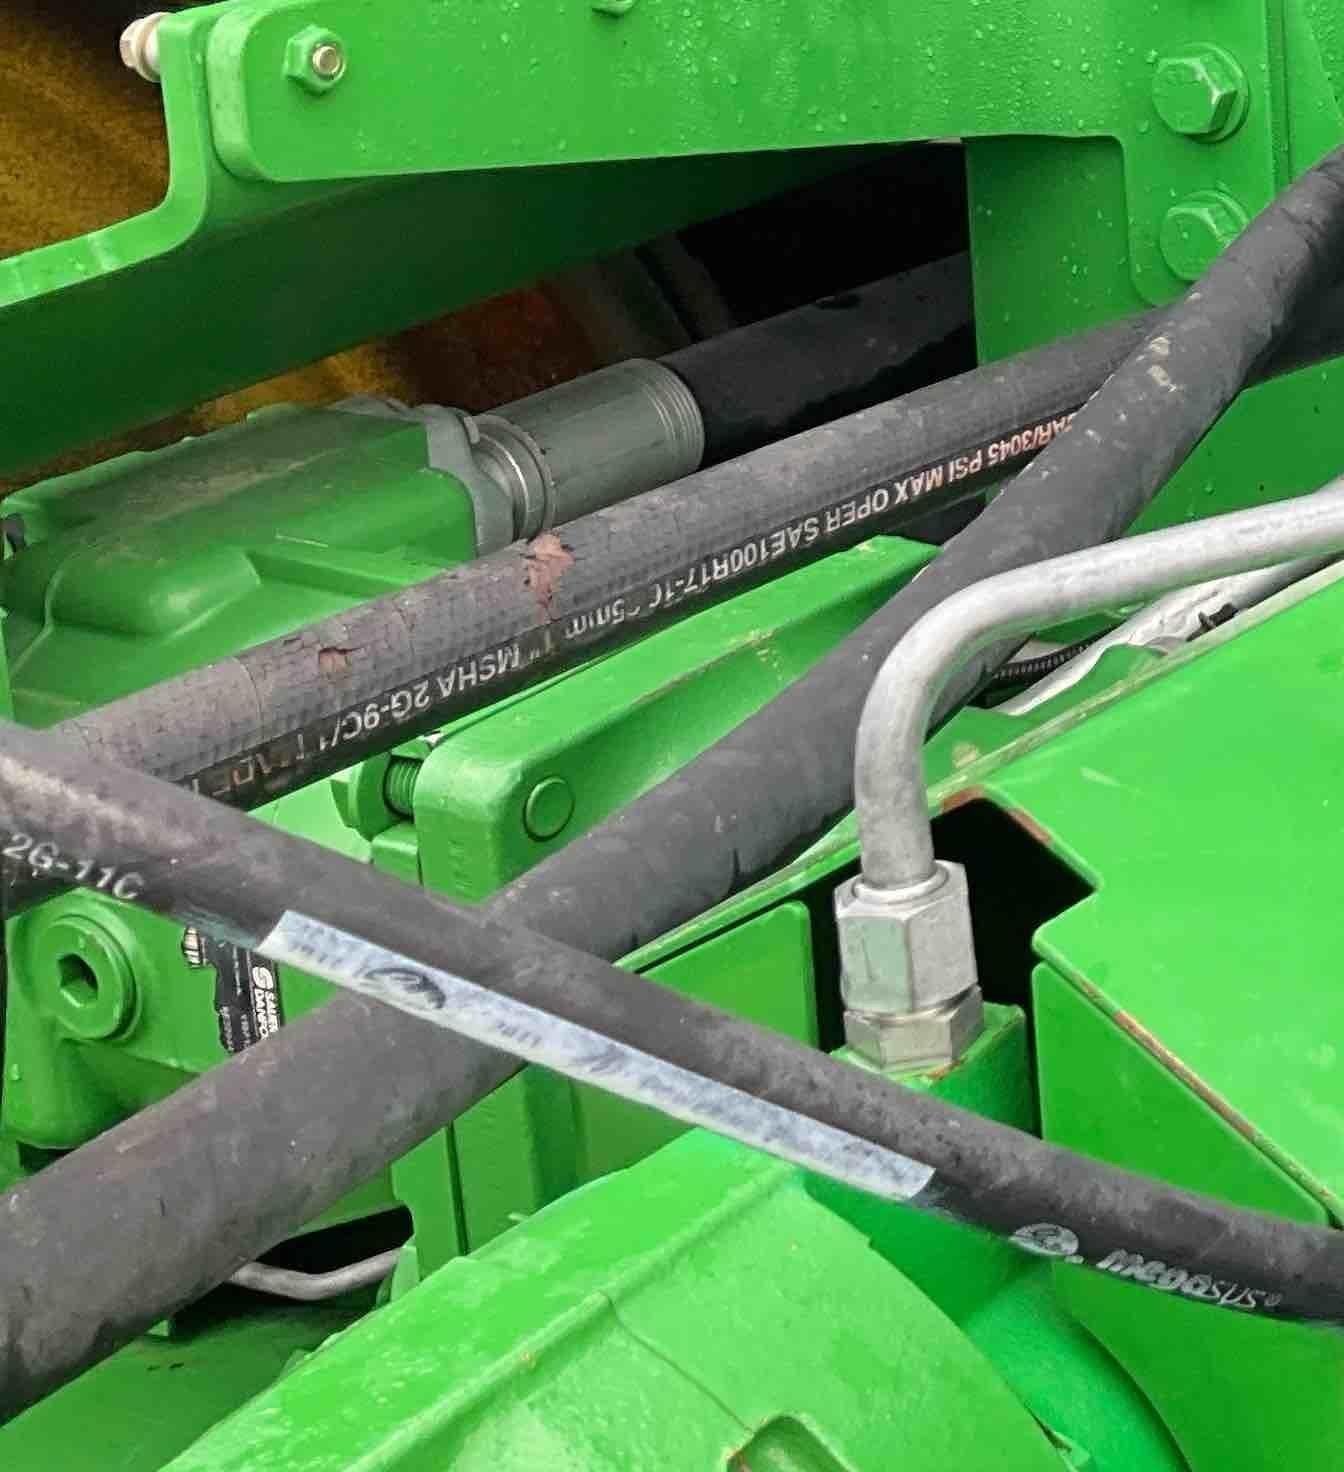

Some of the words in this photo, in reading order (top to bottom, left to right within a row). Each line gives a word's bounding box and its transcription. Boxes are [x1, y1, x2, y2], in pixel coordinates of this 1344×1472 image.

[894, 466, 945, 504] MAX
[949, 448, 982, 483] PSI
[826, 490, 890, 533] OPER
[438, 646, 521, 699] MSHA
[254, 987, 269, 1041] DANFO
